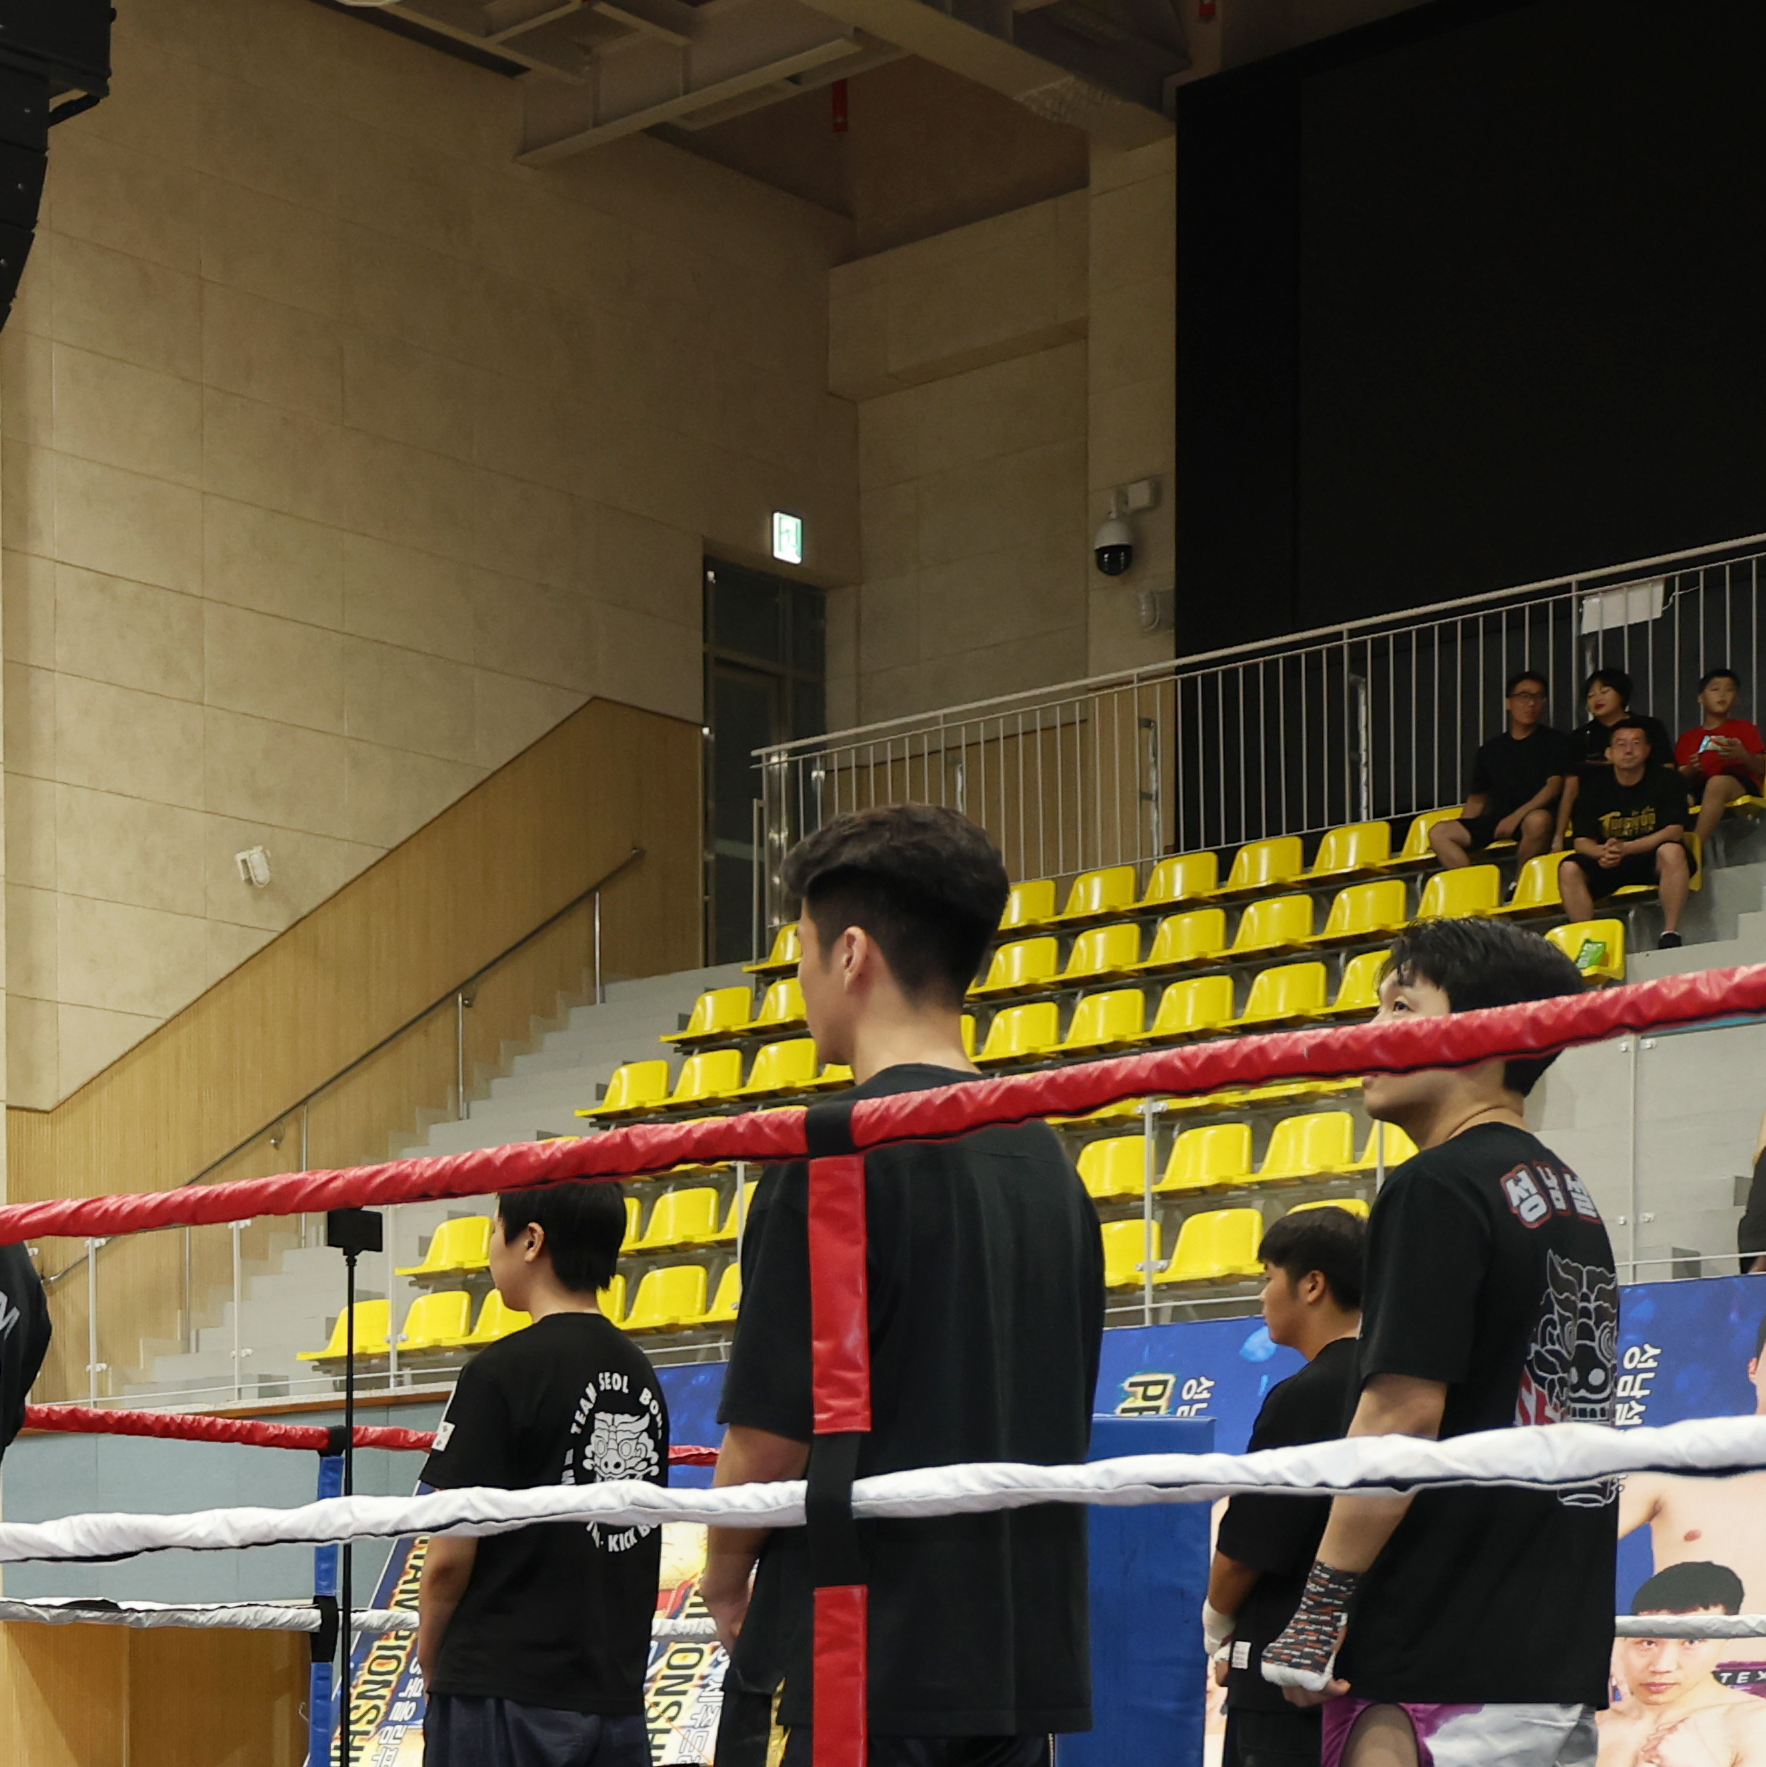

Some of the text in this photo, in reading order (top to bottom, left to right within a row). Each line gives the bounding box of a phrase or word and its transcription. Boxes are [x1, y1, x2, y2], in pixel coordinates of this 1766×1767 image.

[571, 1383, 597, 1435] TEAM
[599, 1372, 629, 1393] SEOL
[608, 1528, 638, 1552] KICK
